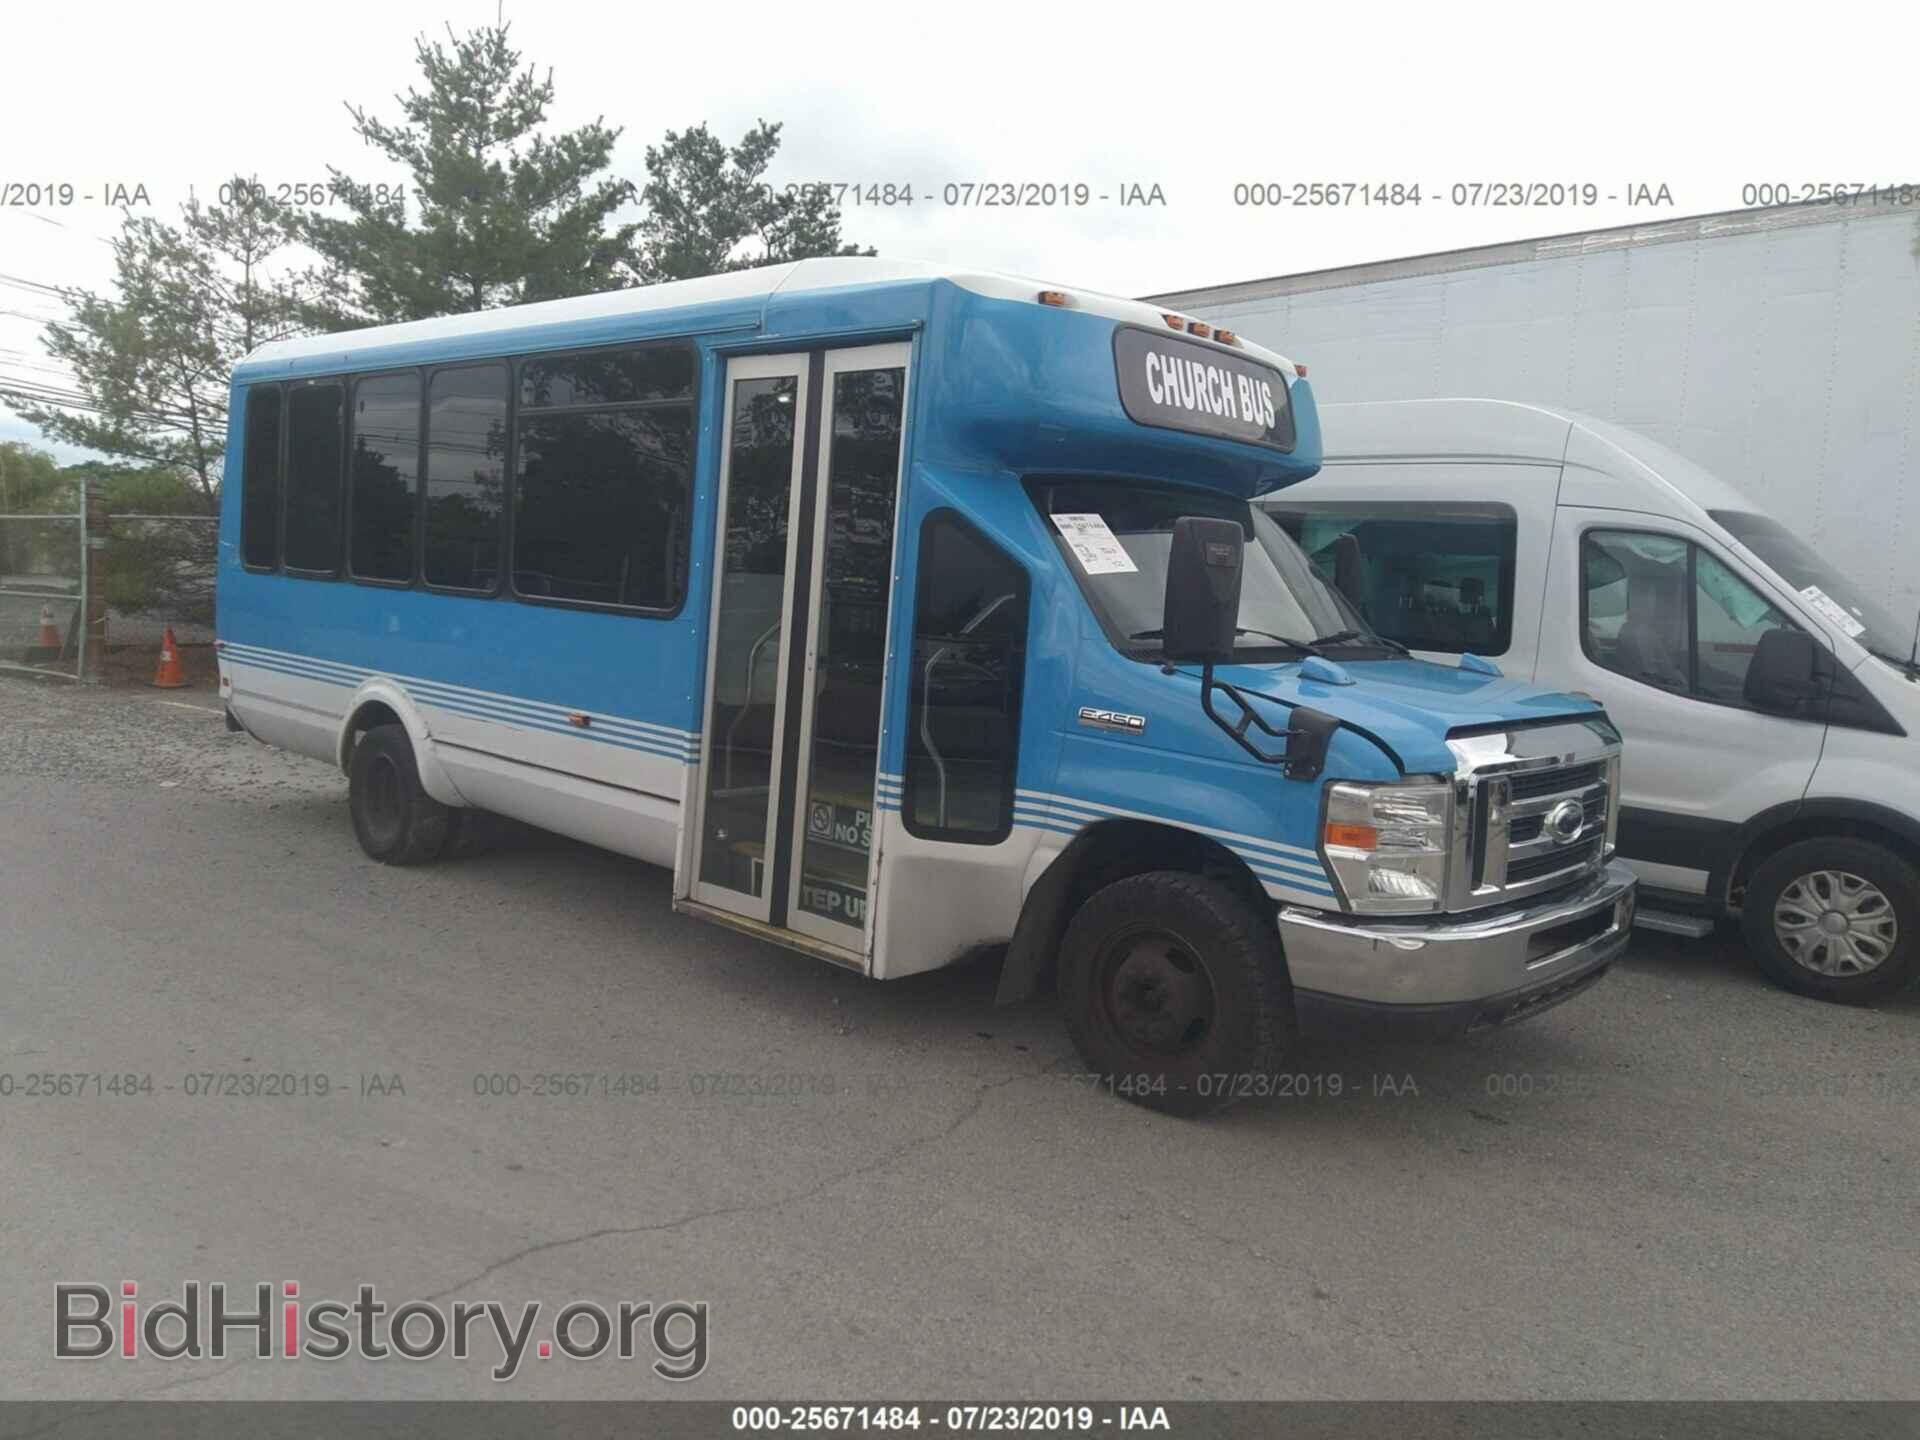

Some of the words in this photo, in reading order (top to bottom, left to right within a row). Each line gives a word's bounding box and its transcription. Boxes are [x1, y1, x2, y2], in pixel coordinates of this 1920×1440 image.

[1145, 352, 1237, 419] CHURCH
[1238, 373, 1275, 429] BUS
[835, 823, 859, 844] NO
